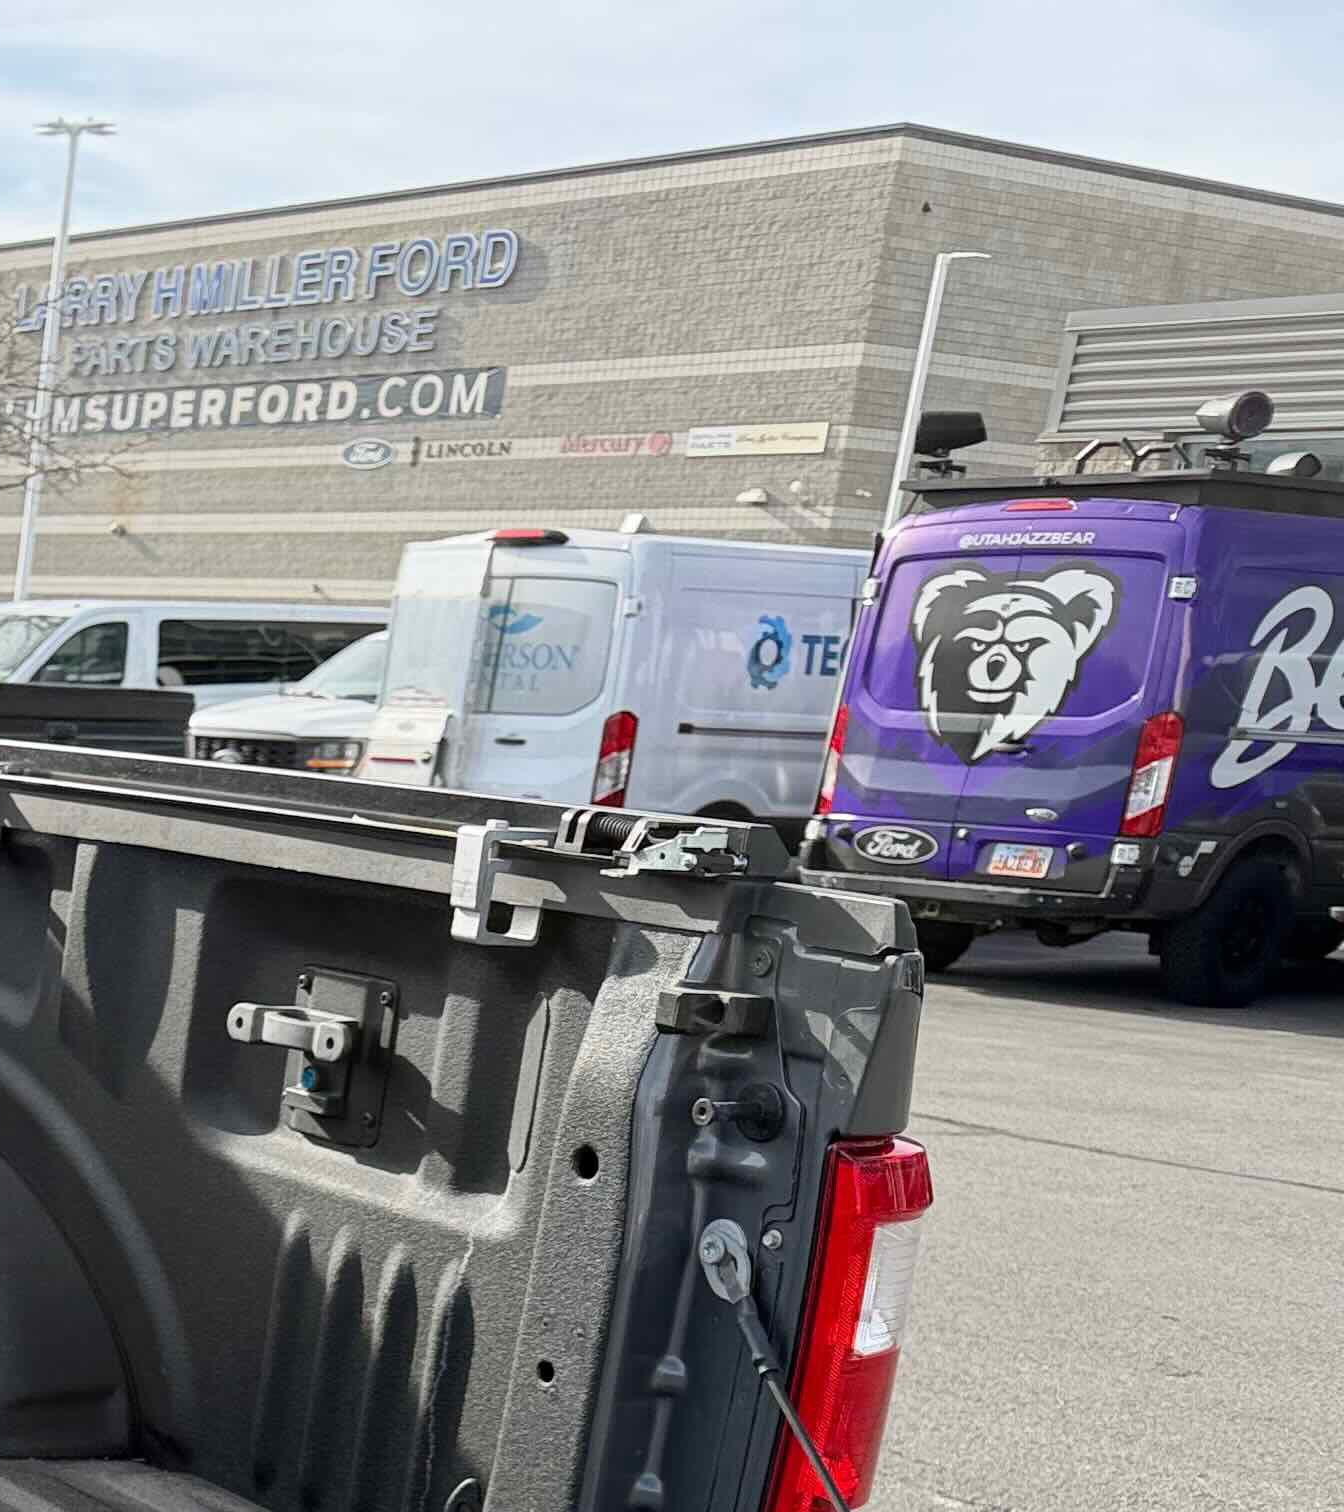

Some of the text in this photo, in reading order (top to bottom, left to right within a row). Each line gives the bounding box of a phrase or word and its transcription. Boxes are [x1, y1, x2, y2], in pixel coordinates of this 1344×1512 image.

[186, 246, 361, 319] MILLER
[365, 228, 520, 301] FORD
[70, 306, 441, 377] PARTS WAREHOUSE
[425, 440, 513, 460] LINCOLN
[559, 431, 643, 455] Mercury
[959, 531, 1096, 549] @UTAHJAZZBEAR
